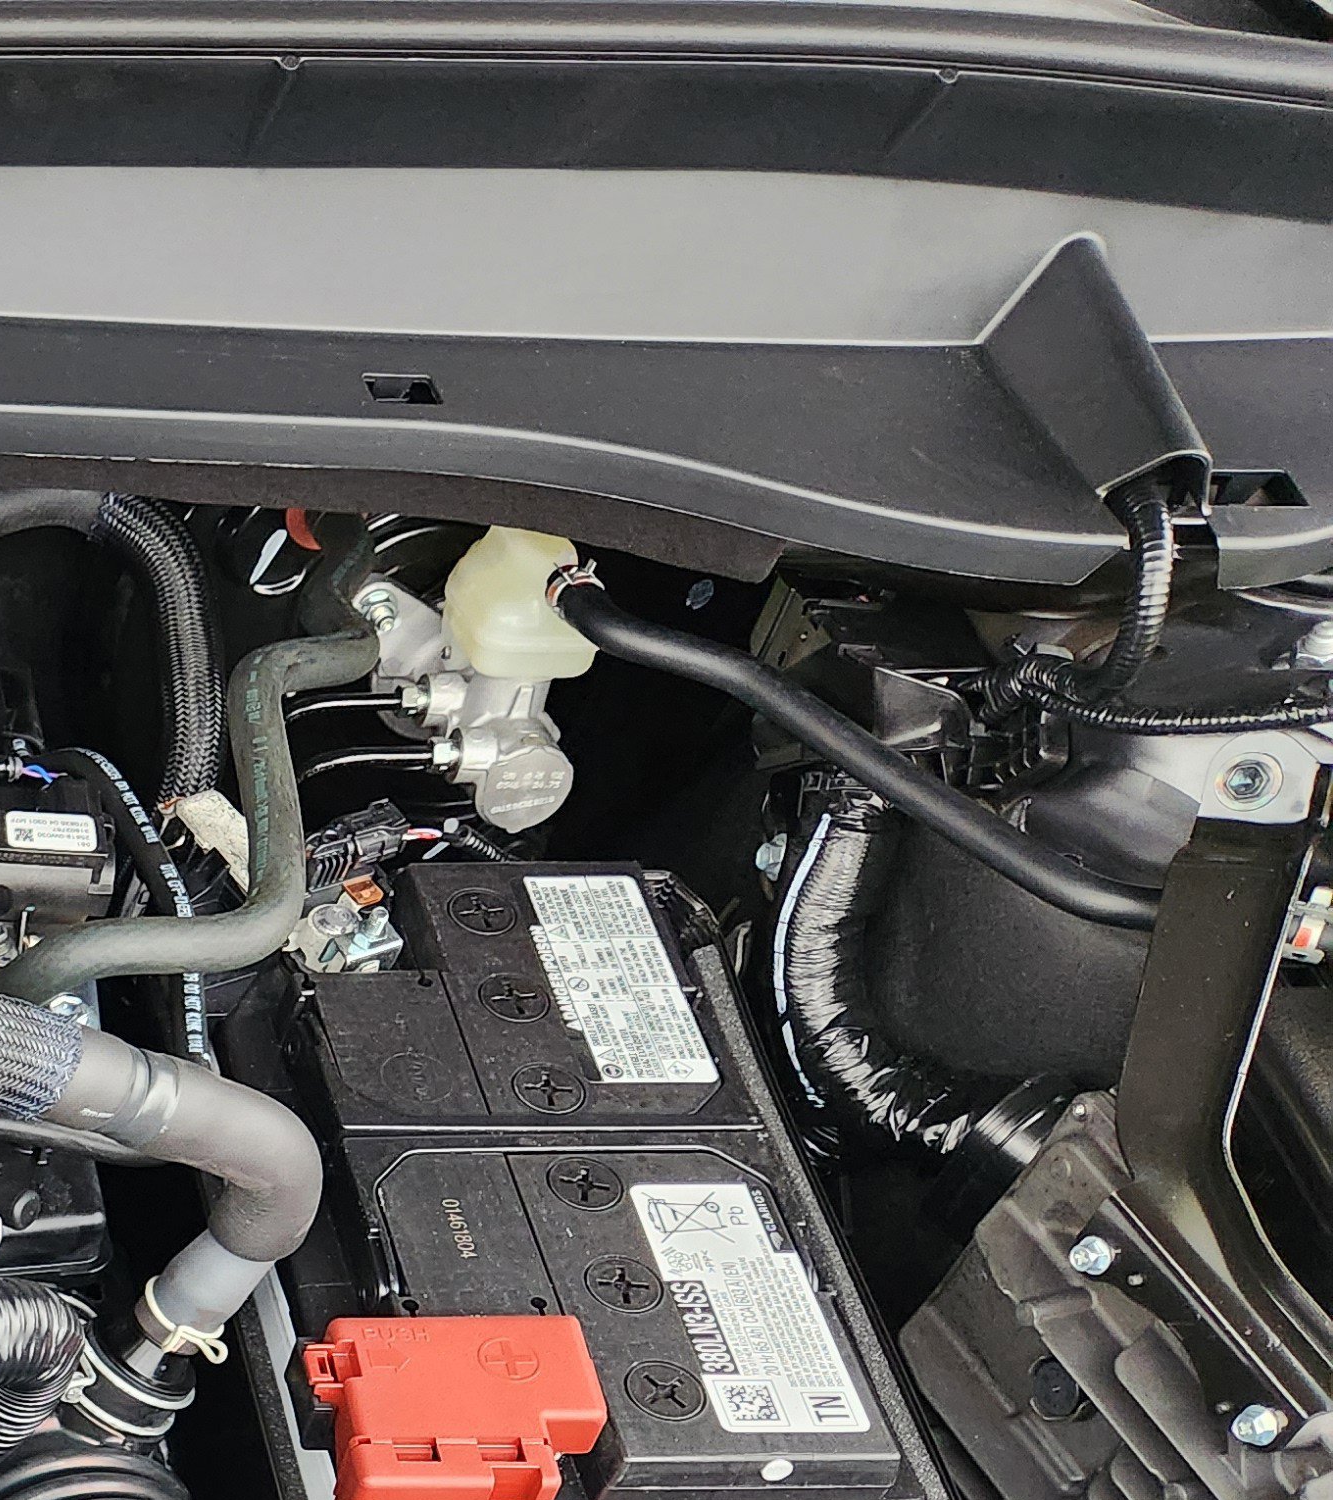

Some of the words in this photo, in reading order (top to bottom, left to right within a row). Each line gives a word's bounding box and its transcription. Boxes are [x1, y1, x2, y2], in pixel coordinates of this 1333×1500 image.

[531, 924, 576, 1019] DANGER/POISON
[724, 1206, 749, 1225] Pb
[748, 1188, 779, 1231] CLARIOS
[443, 1197, 478, 1260] 01461804
[719, 1261, 742, 1277] (EN)
[737, 1307, 759, 1322] CCA
[360, 1326, 431, 1341] PUSH
[668, 1281, 736, 1372] 380LN3-ISS
[746, 1328, 765, 1339] Ah
[751, 1341, 770, 1351] 65
[807, 1395, 852, 1422] TN
